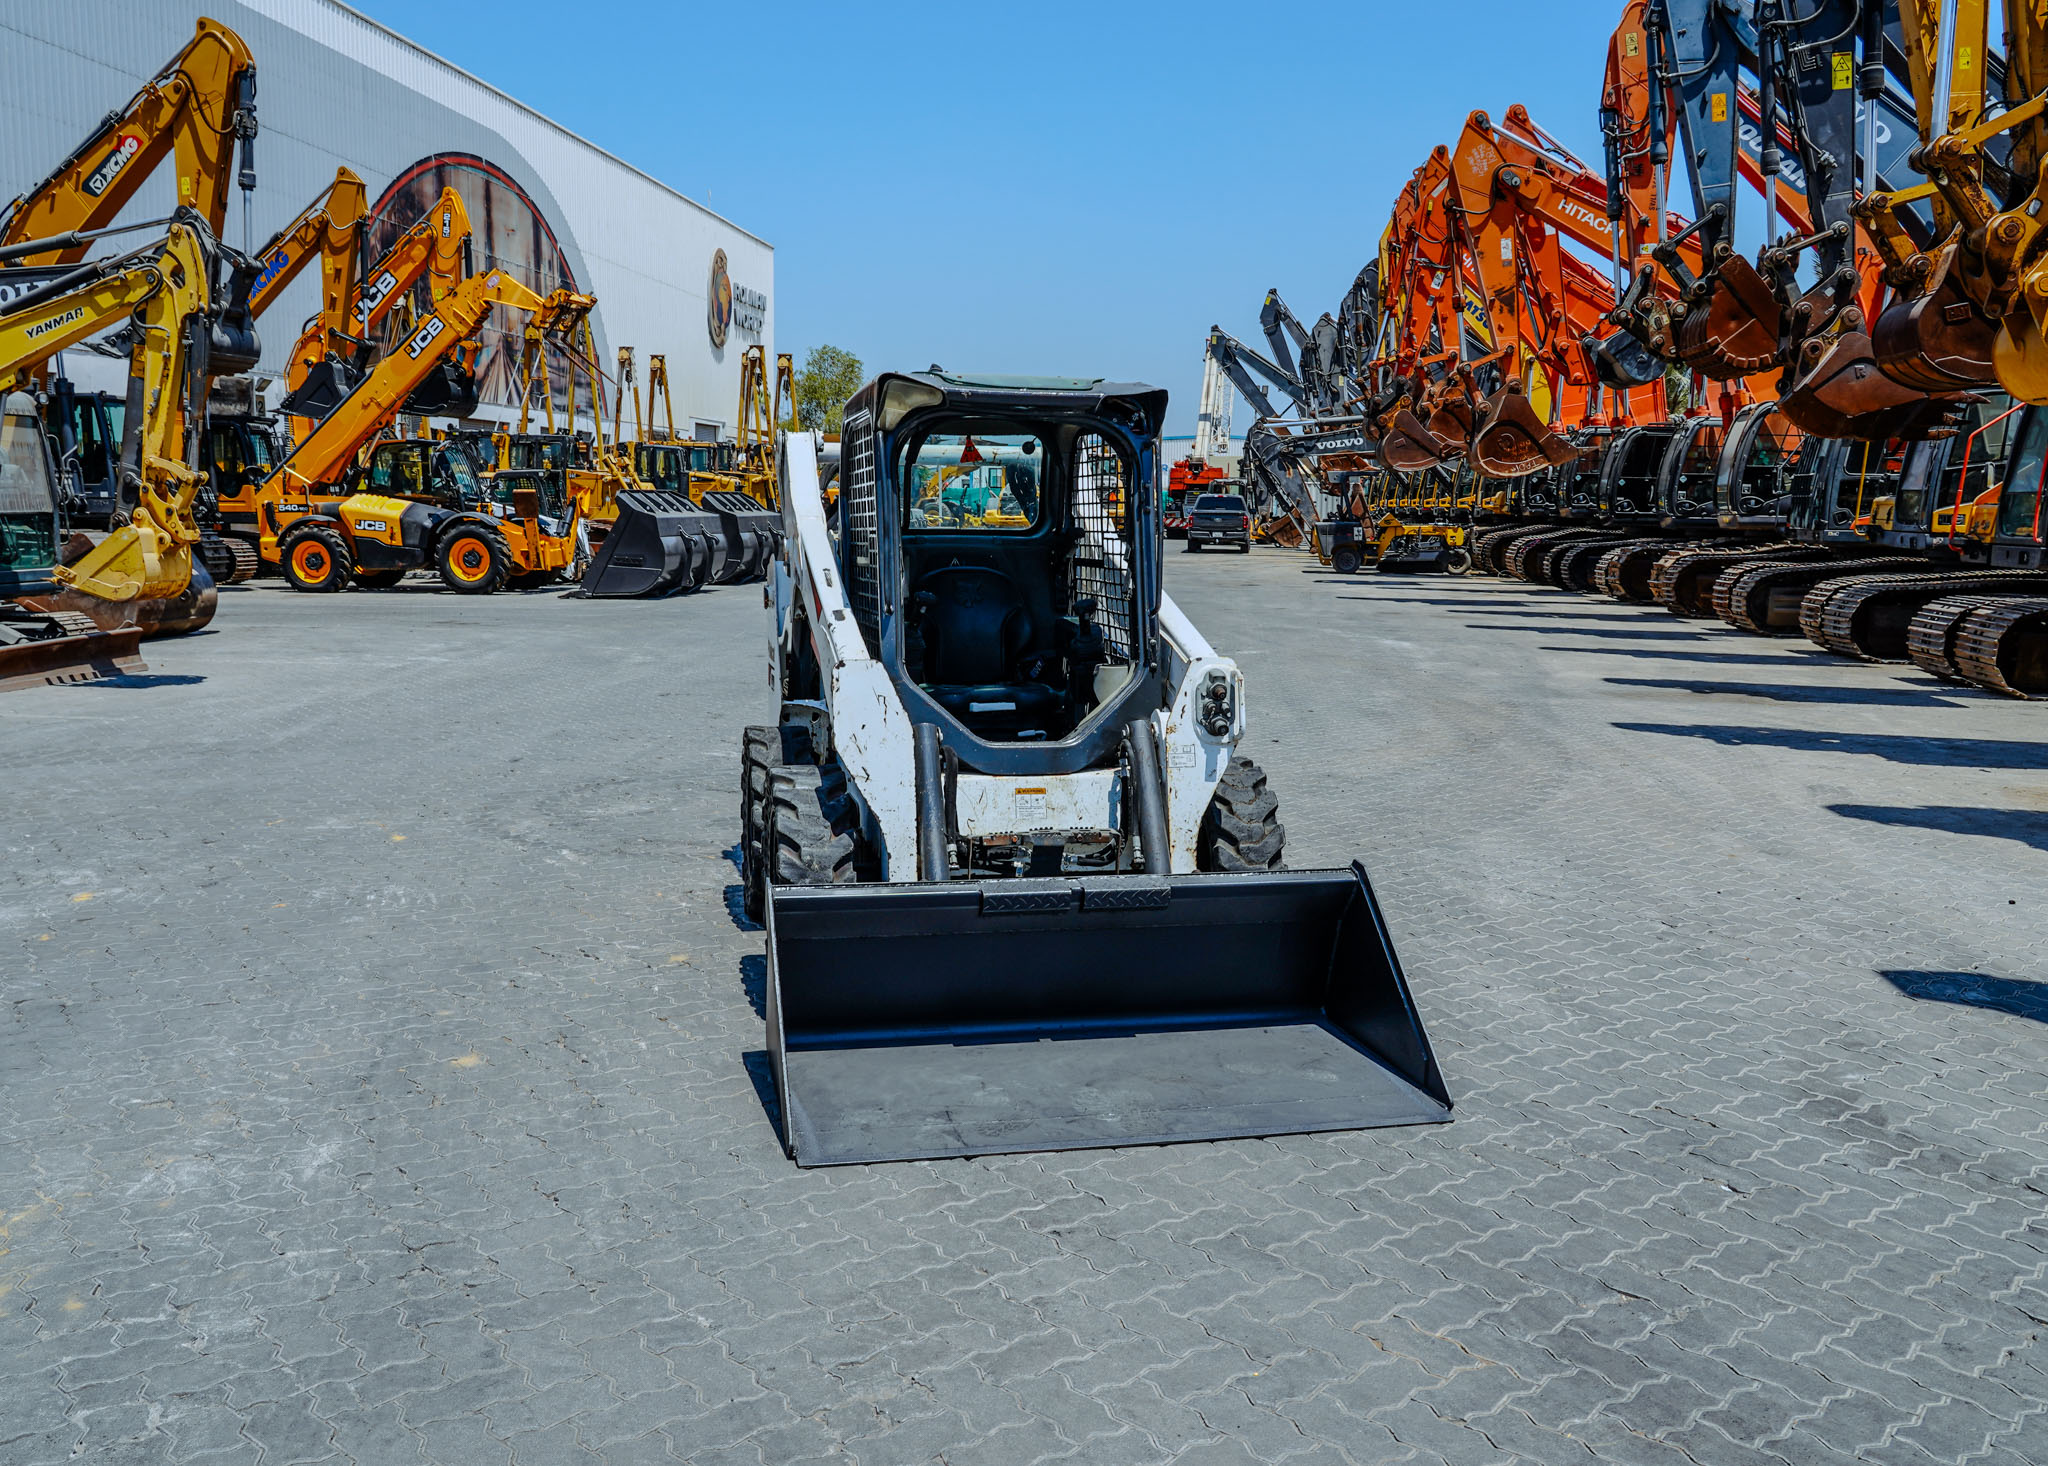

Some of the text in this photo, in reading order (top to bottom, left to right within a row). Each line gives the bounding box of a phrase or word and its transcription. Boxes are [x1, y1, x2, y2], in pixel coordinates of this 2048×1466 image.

[101, 136, 138, 183] XCMG
[355, 271, 399, 322] JCB
[25, 305, 85, 339] YANMAR
[409, 316, 446, 360] JCB
[1315, 437, 1364, 450] VOLVO
[355, 520, 387, 532] JCB
